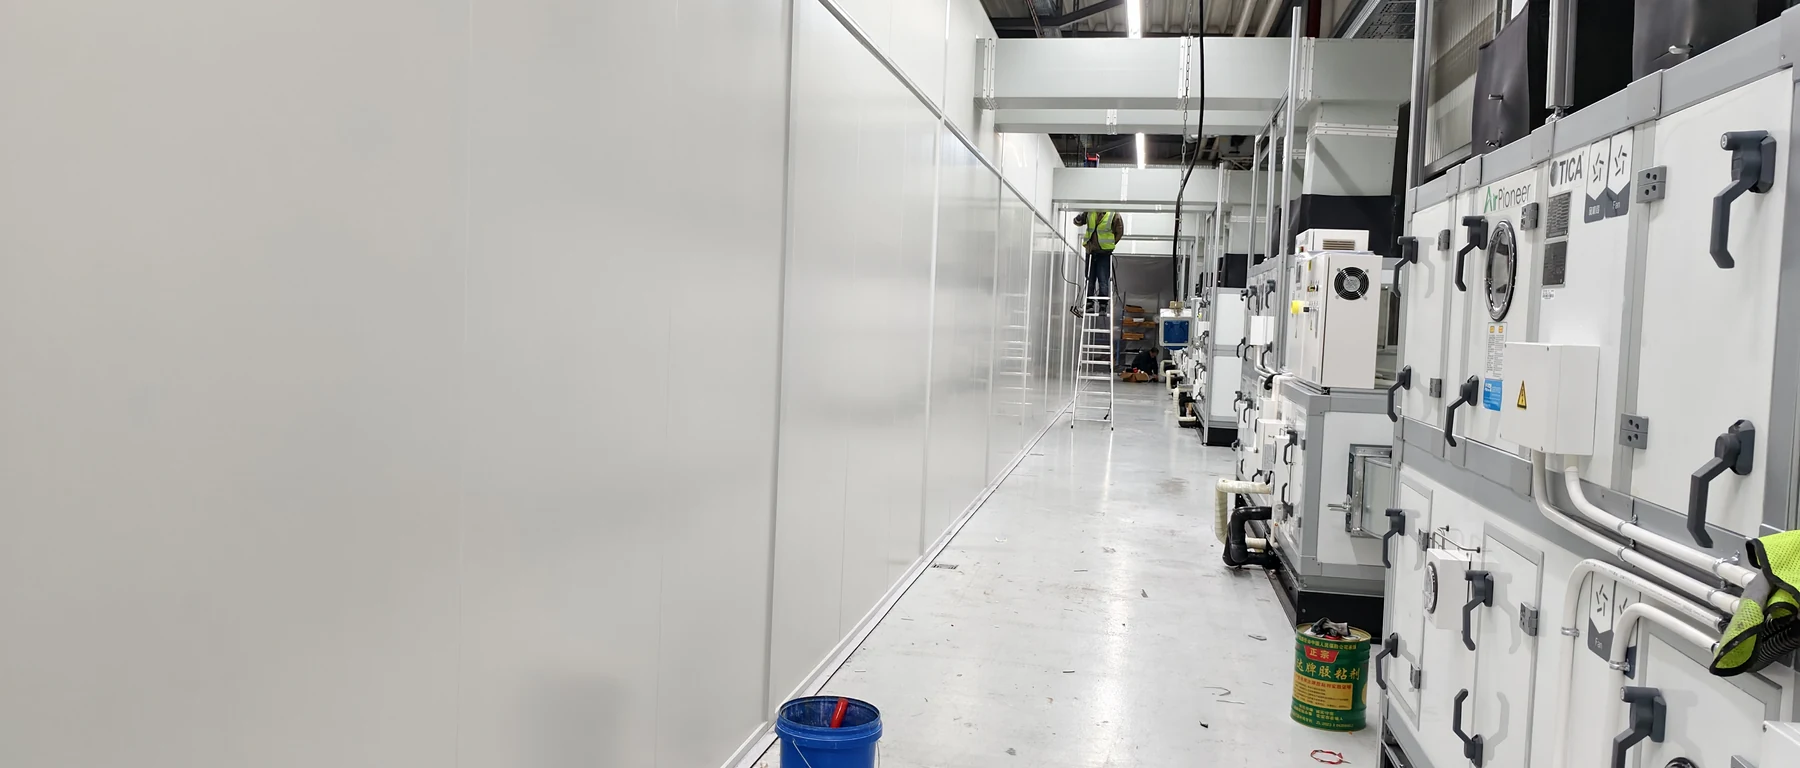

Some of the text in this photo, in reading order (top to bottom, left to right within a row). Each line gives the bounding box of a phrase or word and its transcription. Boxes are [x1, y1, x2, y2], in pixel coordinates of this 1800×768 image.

[1559, 154, 1583, 185] TICA
[1612, 200, 1621, 209] Fan
[1594, 637, 1603, 650] Fan
[1309, 648, 1330, 659] 正宗
